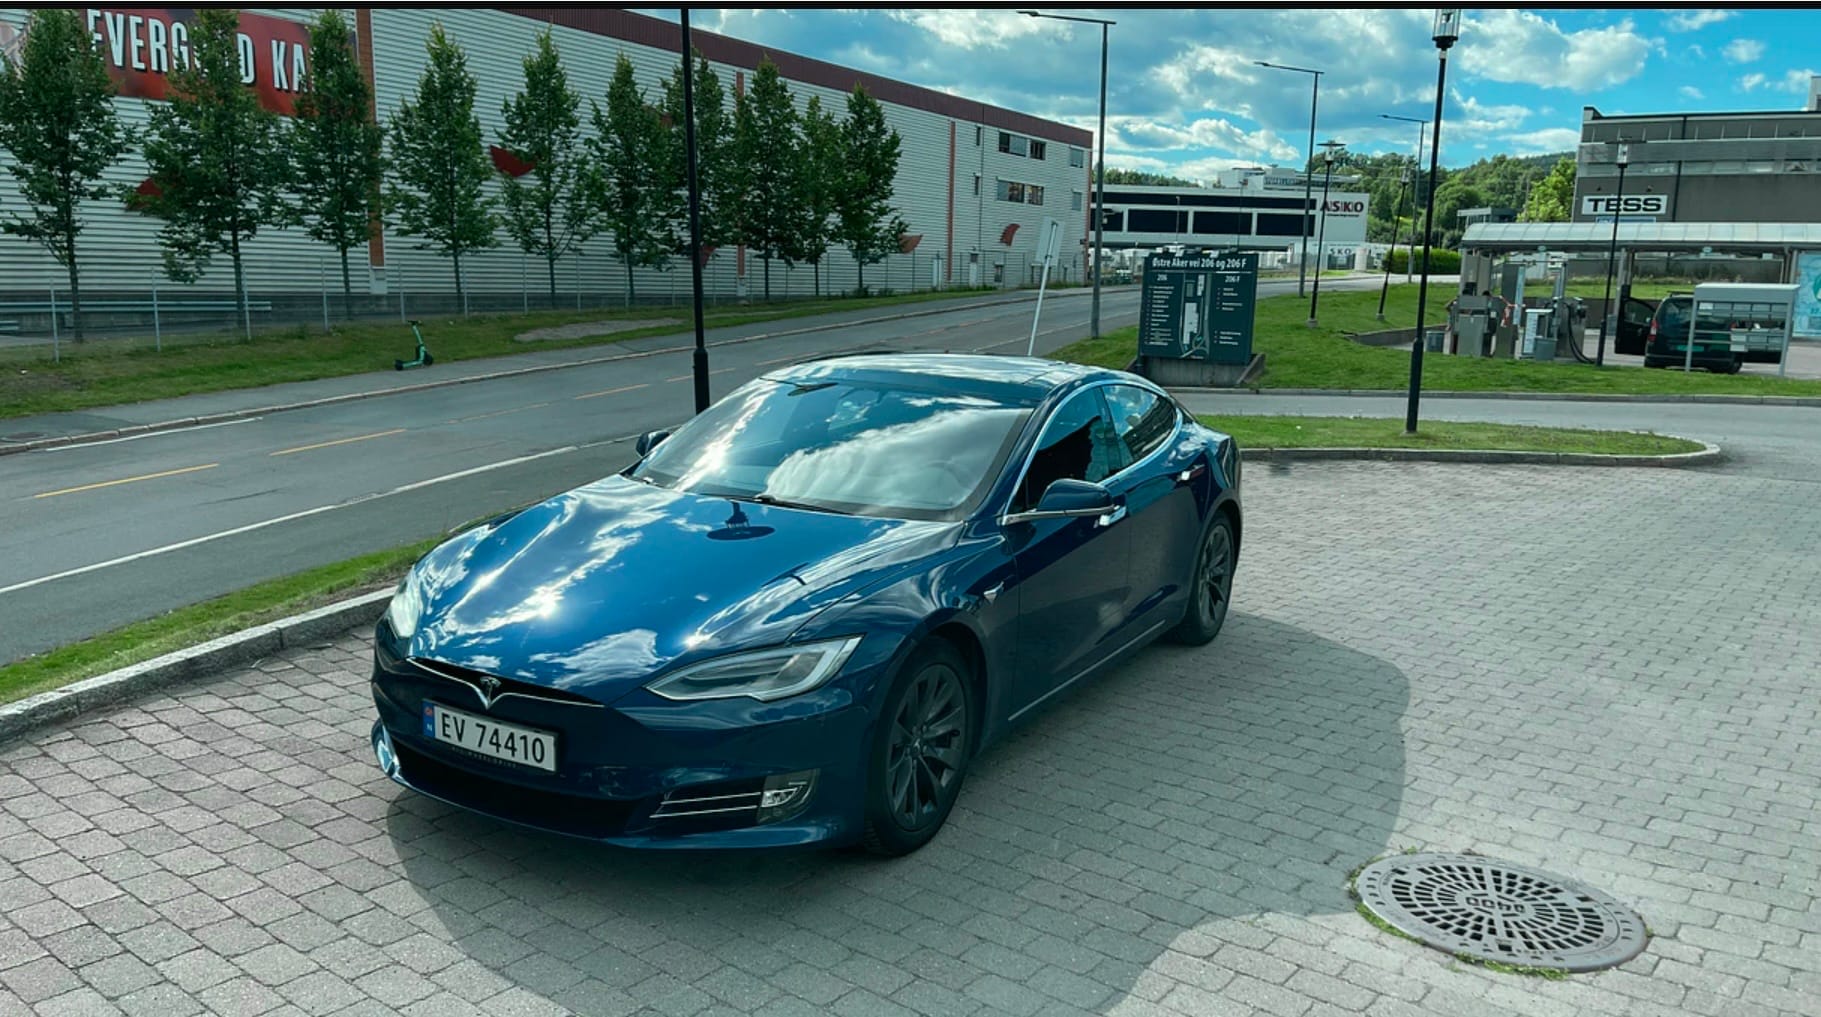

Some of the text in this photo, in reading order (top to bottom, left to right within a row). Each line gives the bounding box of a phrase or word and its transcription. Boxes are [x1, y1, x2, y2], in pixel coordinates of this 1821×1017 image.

[87, 9, 255, 84] EVERGD
[1320, 200, 1364, 213] ASKO
[1587, 197, 1662, 212] TESS
[1172, 257, 1188, 267] Aker
[1189, 258, 1200, 267] vei
[1201, 258, 1215, 268] 206
[1215, 260, 1226, 271] og
[1226, 258, 1241, 268] 206
[1241, 258, 1247, 269] F
[441, 713, 466, 743] EV
[475, 722, 546, 764] 74410
